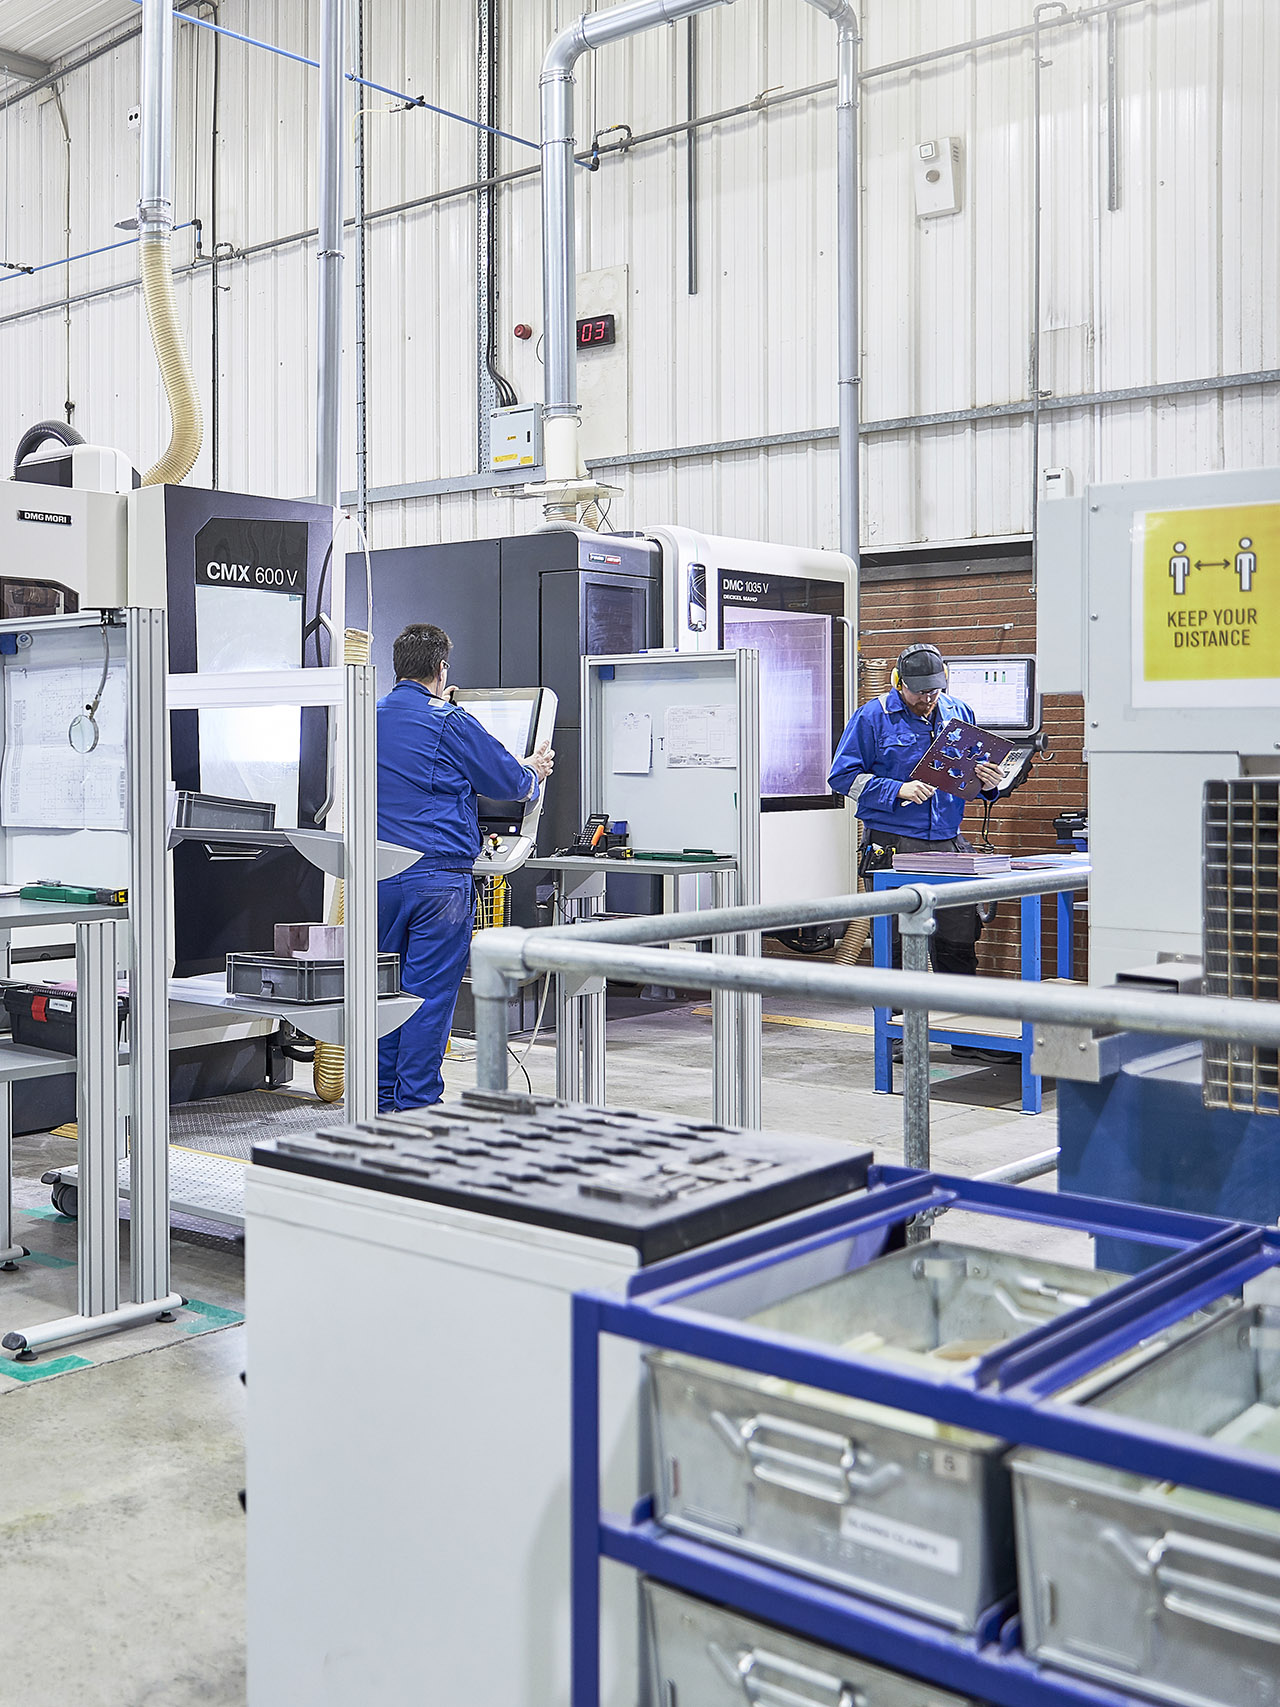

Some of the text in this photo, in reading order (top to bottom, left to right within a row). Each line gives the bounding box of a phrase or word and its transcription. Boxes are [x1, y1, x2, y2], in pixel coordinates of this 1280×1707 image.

[24, 512, 67, 523] DMG MORI
[206, 561, 298, 586] CMX 600 V
[722, 579, 769, 594] DMC 1035 V
[1167, 608, 1257, 628] KEEP YOUR
[1174, 629, 1250, 648] DISTANCE
